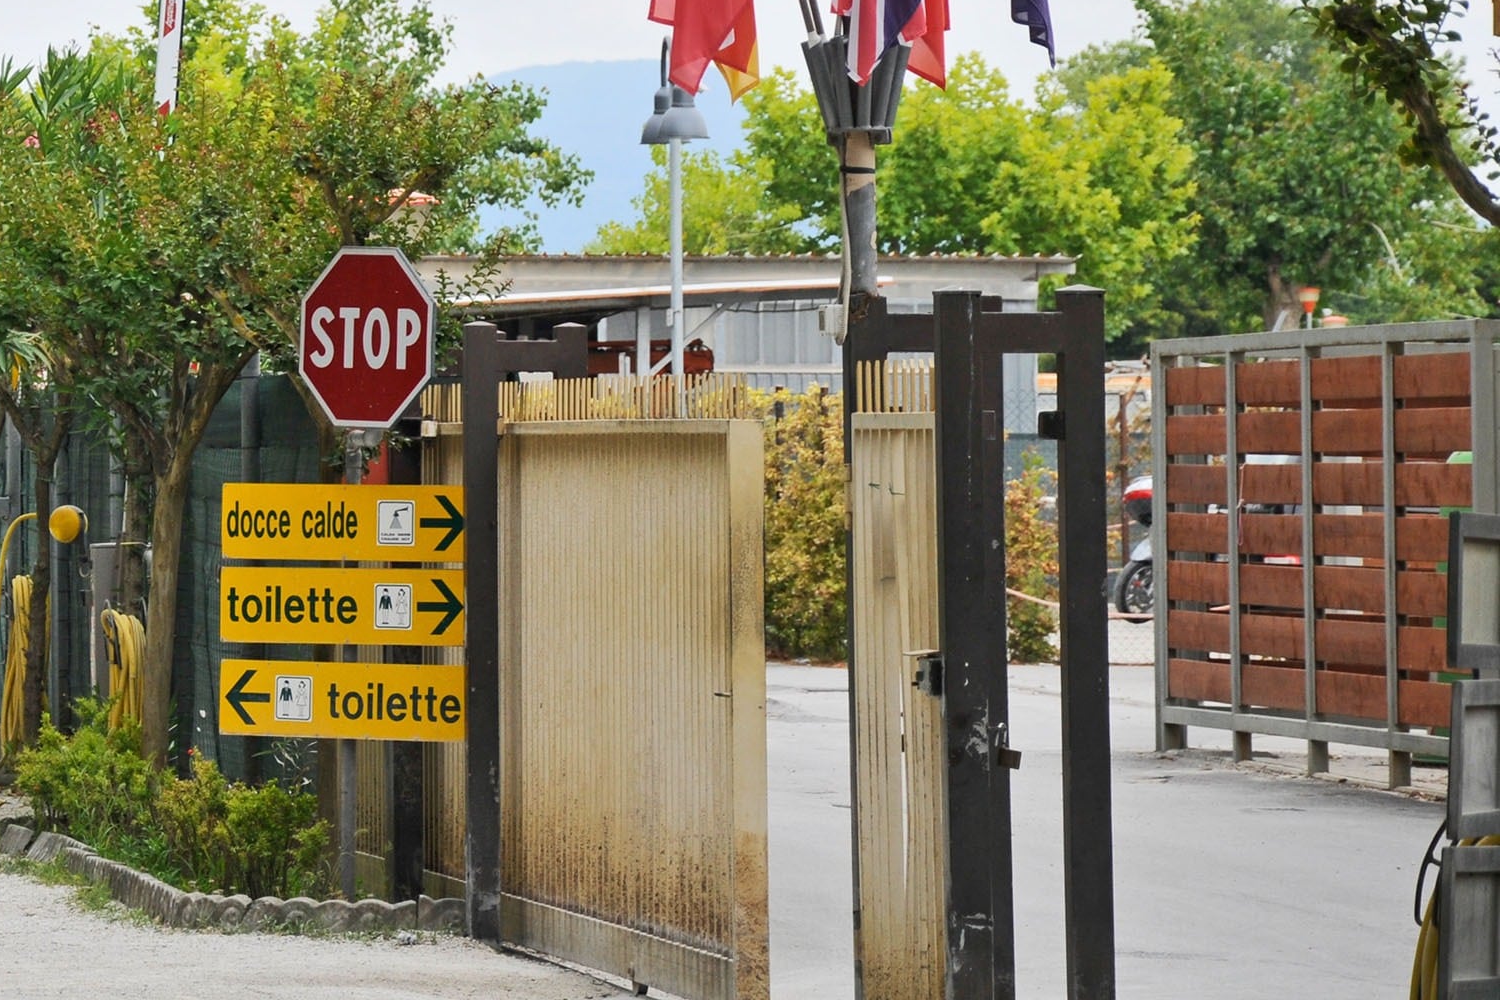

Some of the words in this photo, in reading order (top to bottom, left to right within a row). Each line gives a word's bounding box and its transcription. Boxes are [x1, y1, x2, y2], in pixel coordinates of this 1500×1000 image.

[310, 306, 421, 370] STOP
[227, 501, 291, 538] docce
[302, 501, 358, 538] calde
[227, 586, 358, 624] toilette
[328, 683, 461, 723] toilette
